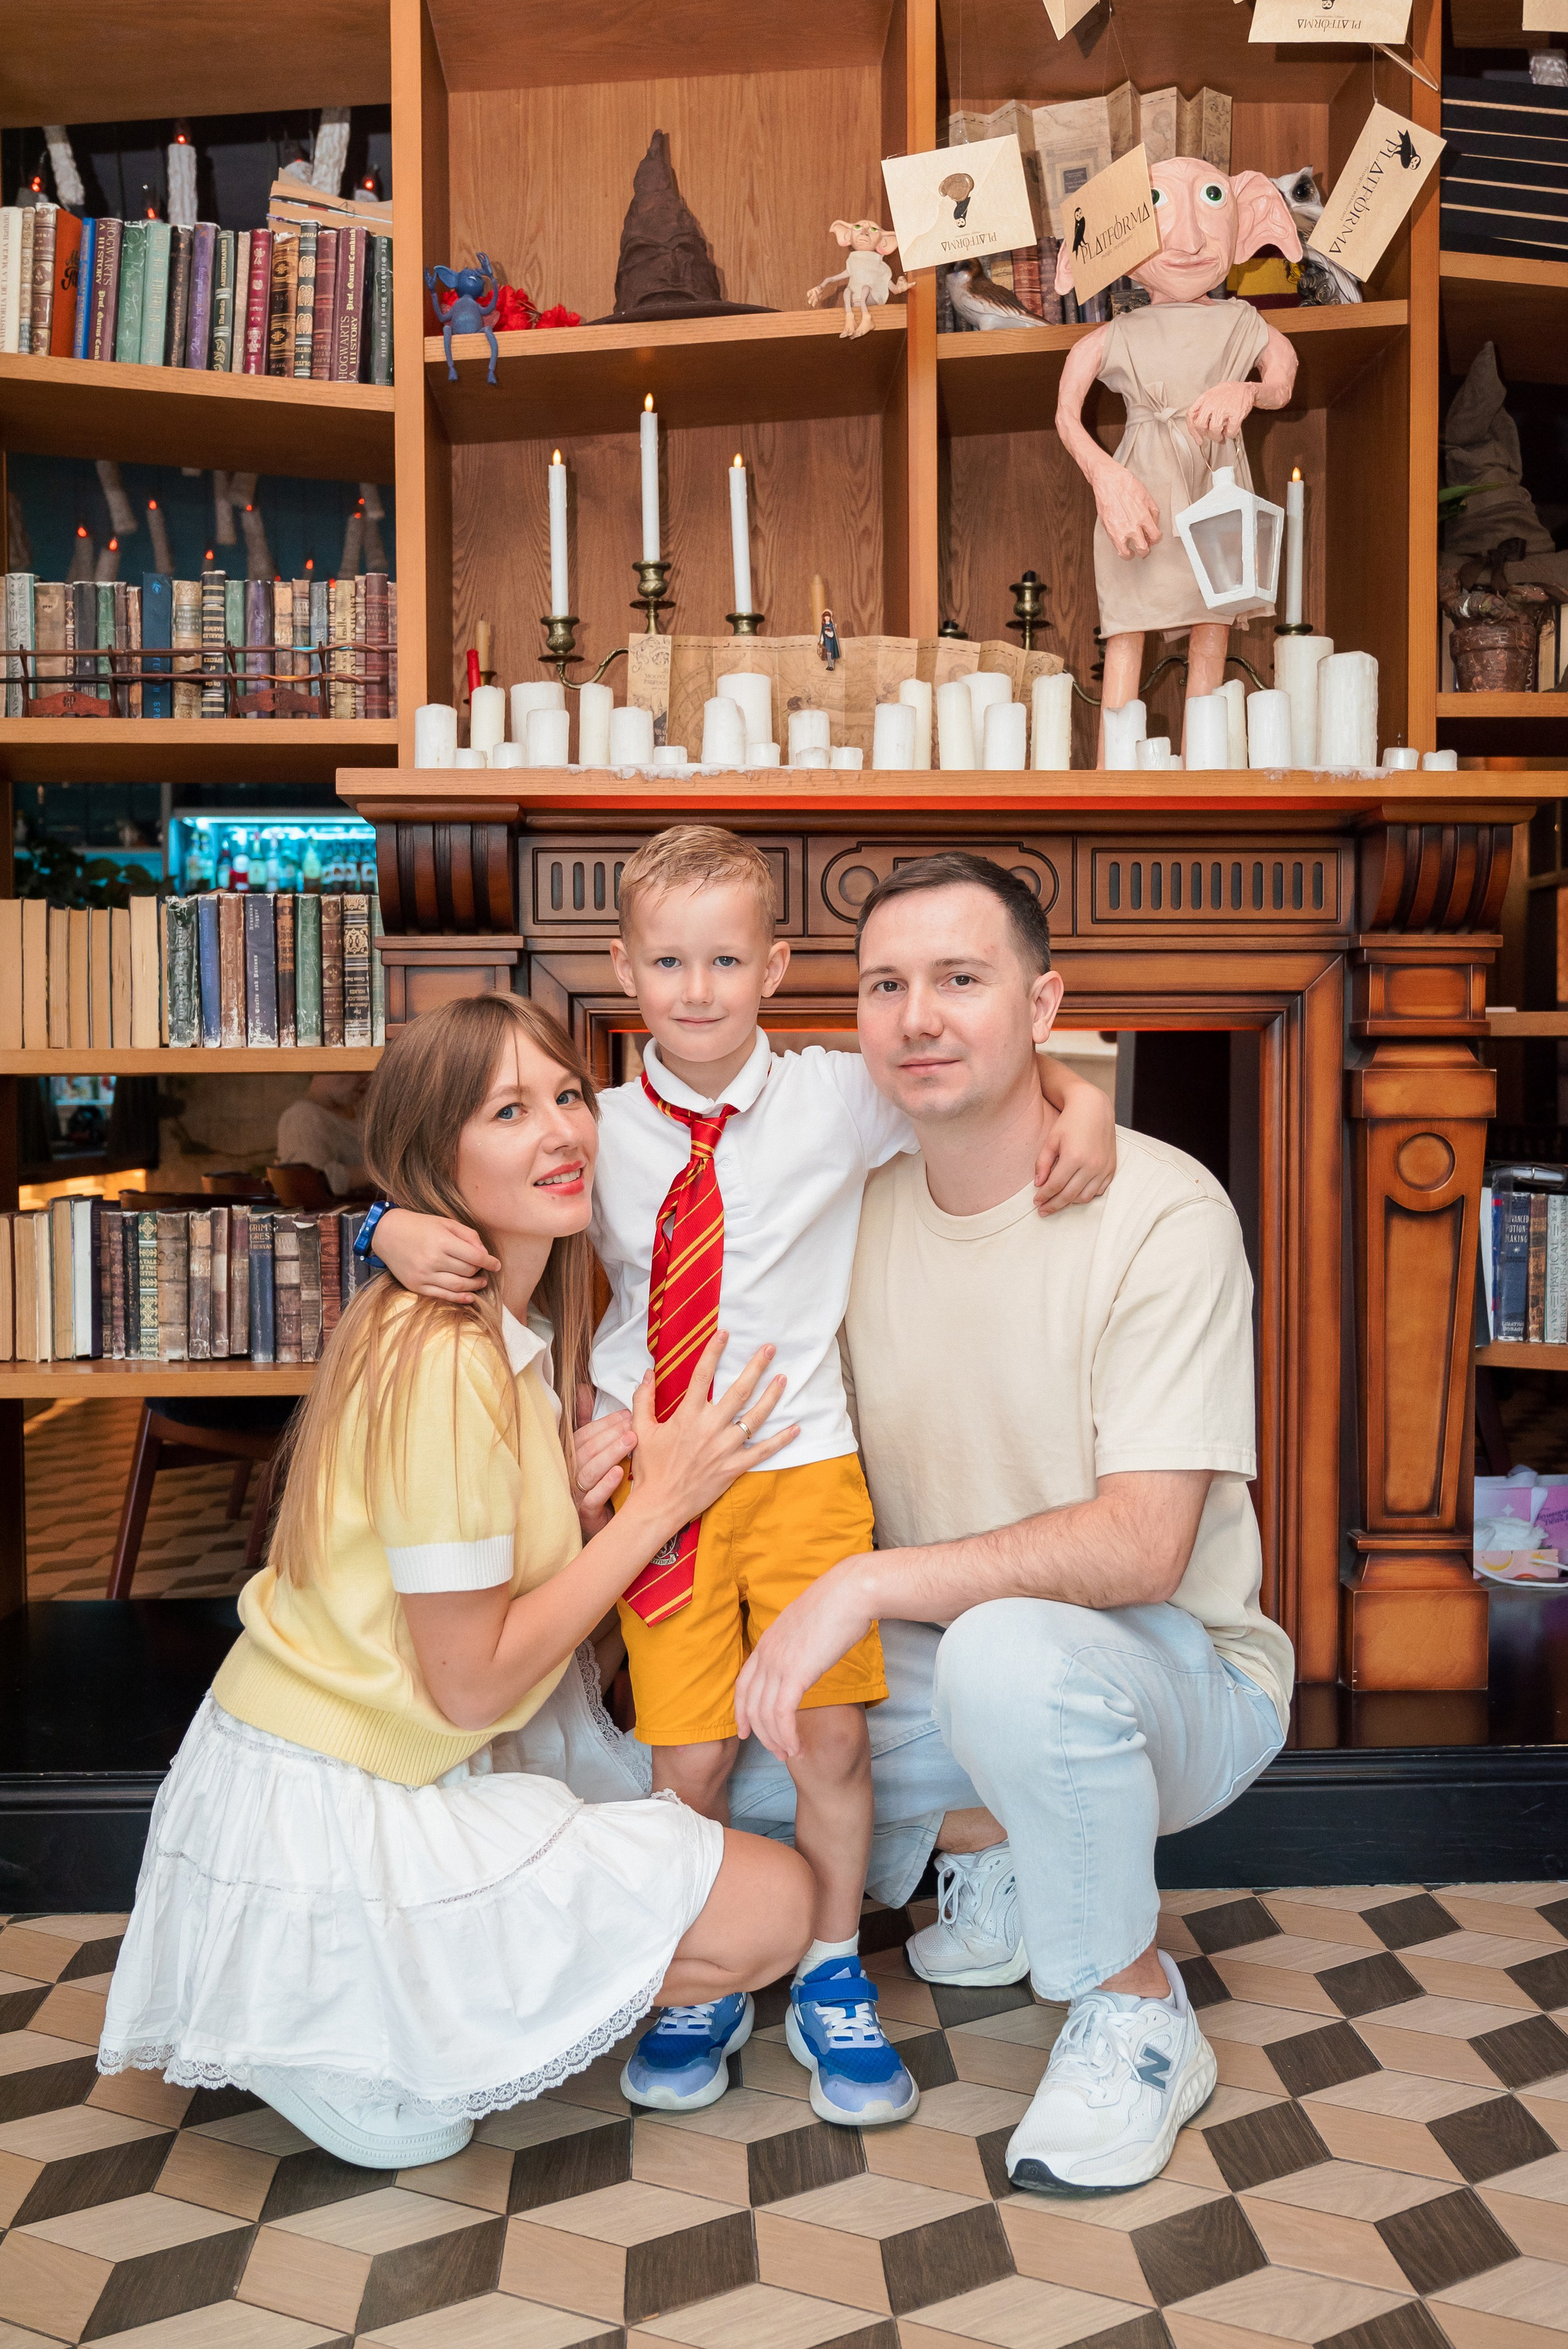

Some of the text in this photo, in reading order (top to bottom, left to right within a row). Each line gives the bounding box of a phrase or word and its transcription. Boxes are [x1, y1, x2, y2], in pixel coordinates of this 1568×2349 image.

[1298, 20, 1361, 32] PLATFORMA
[1329, 138, 1397, 254] PLATFORMA
[1340, 166, 1368, 221] magic restaurant
[103, 221, 116, 286] HOGWARTS
[941, 232, 997, 252] PLATFORMA
[1081, 202, 1150, 264] PLATFORMA
[96, 237, 105, 284] HISTORY
[196, 267, 205, 291] making
[338, 316, 350, 379] HOGWARTS
[10, 624, 19, 678] MAGCAL
[1504, 1214, 1529, 1223] ADVANCED
[1504, 1235, 1527, 1243] MAKING
[1505, 1224, 1528, 1233] POTION-
[1550, 1241, 1558, 1293] MAGICAL
